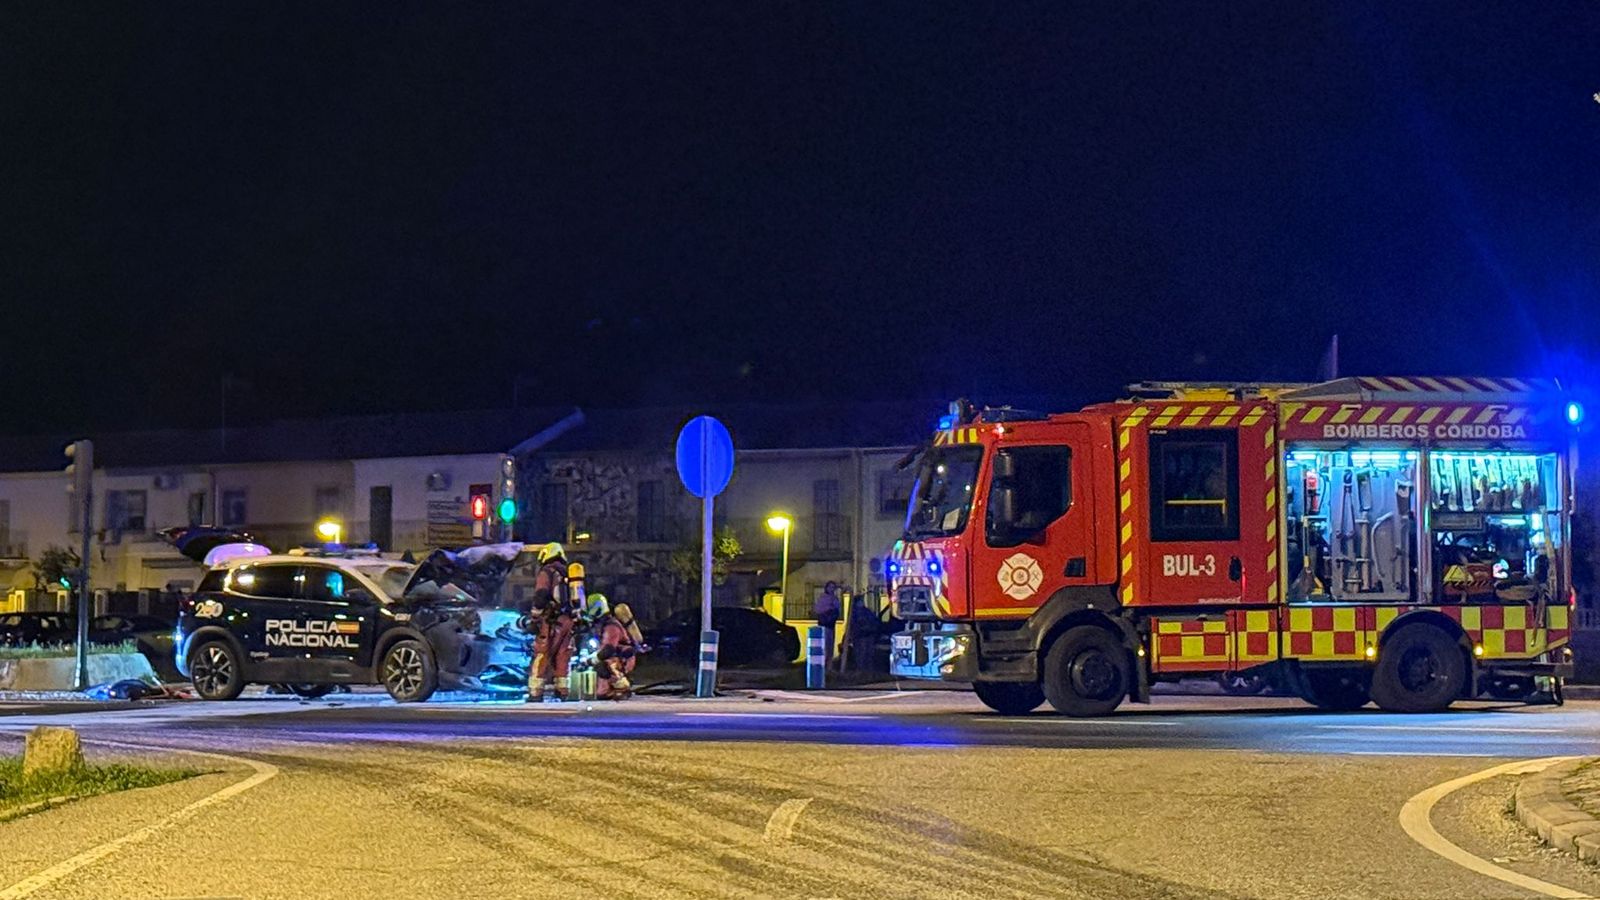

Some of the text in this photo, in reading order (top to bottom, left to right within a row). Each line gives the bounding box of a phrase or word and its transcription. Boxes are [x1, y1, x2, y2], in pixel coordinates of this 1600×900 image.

[1323, 424, 1429, 439] BOMBEROS
[1163, 554, 1216, 576] BUL-3
[265, 619, 340, 633] POLICIA
[265, 633, 359, 648] NACIONAL
